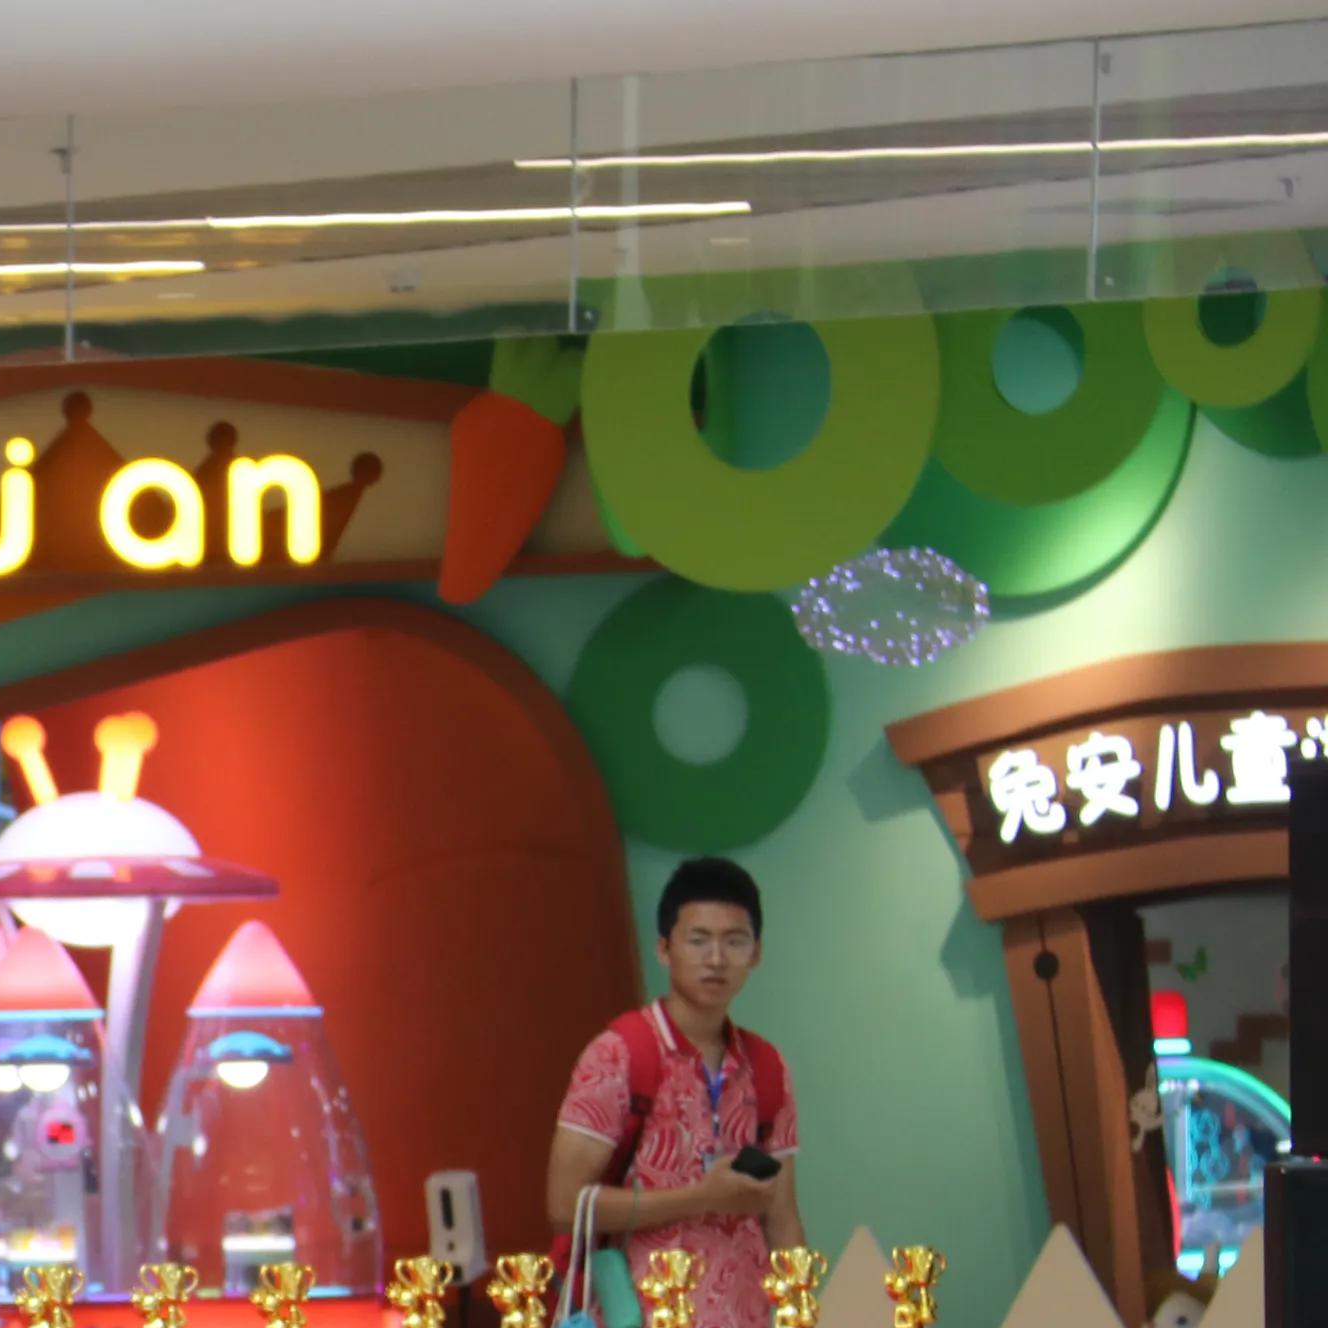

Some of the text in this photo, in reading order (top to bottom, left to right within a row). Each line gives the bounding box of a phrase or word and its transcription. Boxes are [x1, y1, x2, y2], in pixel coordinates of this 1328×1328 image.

[100, 453, 322, 570] an
[988, 710, 1328, 844] 兔安儿童
